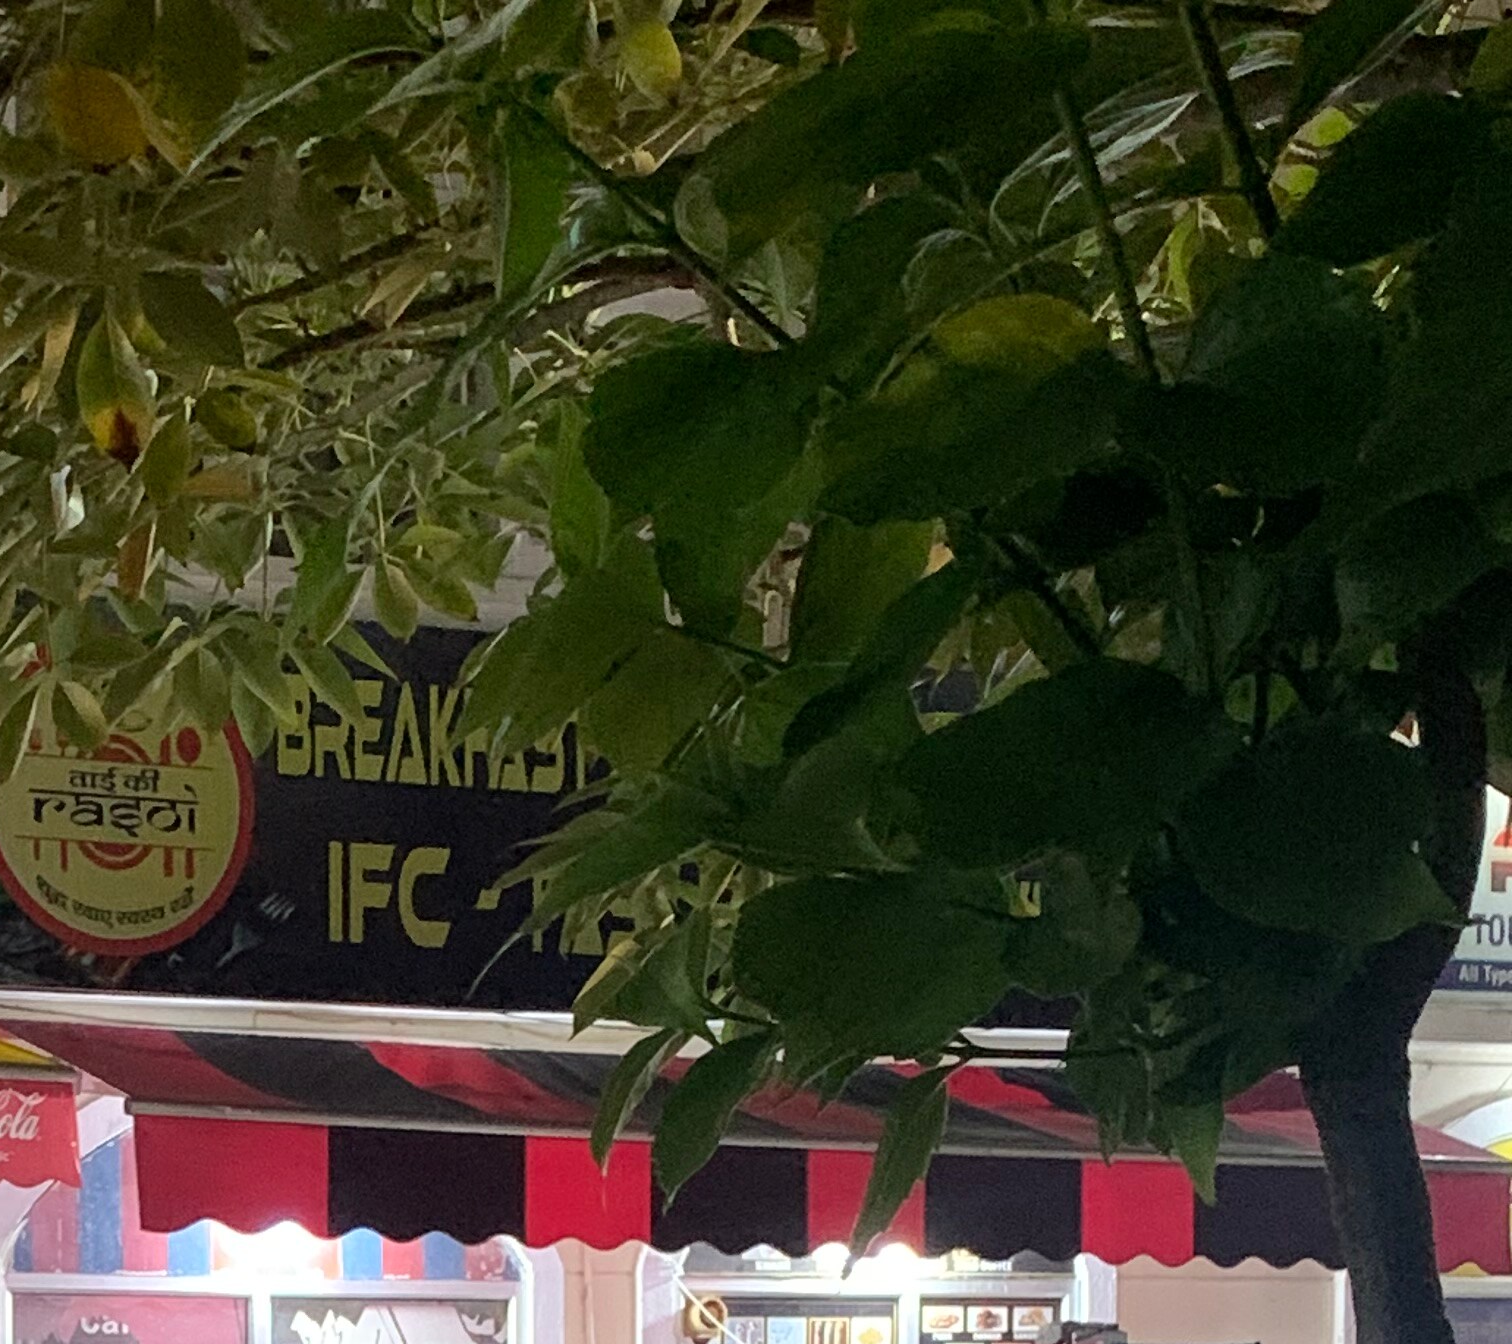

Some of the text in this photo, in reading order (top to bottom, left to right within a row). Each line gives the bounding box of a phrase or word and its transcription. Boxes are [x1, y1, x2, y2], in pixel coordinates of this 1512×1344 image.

[69, 767, 160, 794] ताई की
[328, 841, 451, 949] IFC
[1472, 914, 1512, 946] TO
